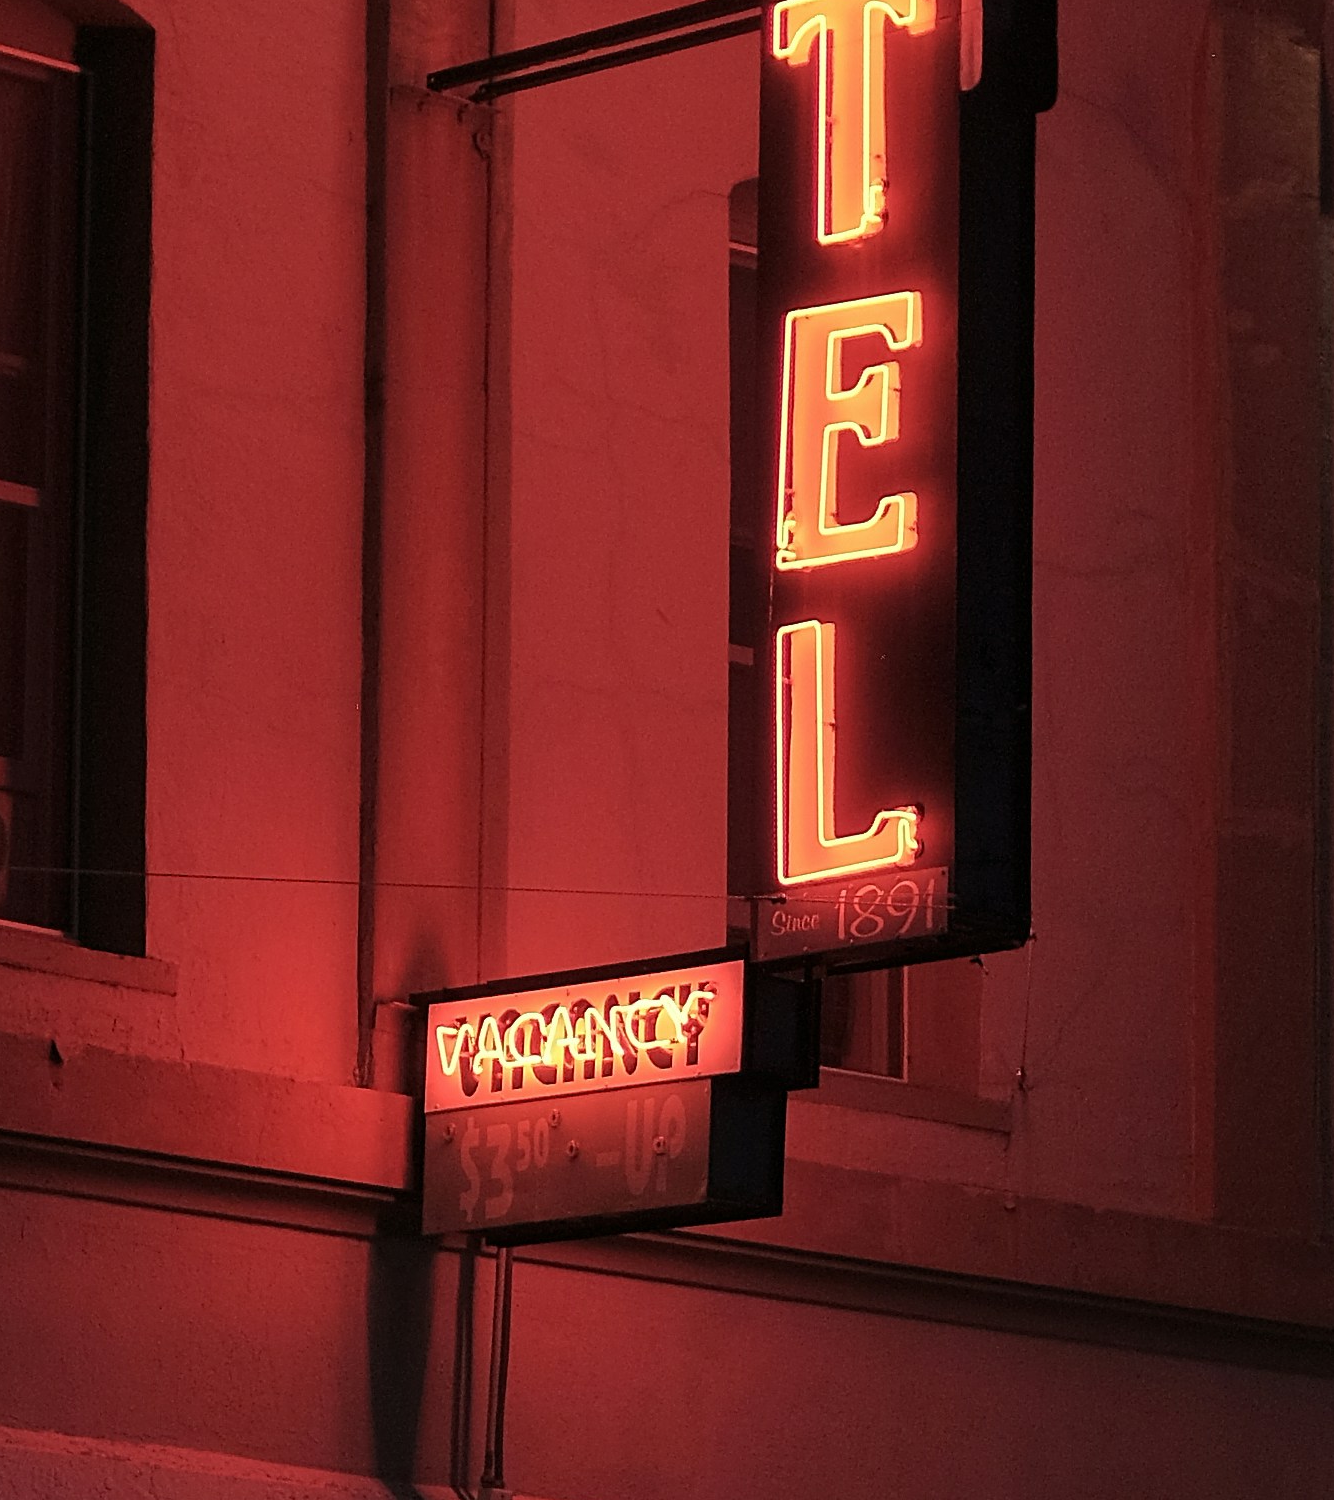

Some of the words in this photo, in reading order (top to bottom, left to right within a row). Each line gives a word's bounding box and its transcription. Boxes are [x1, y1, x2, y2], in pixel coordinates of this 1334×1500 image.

[770, 910, 820, 937] Since
[834, 877, 936, 941] 1891
[434, 980, 717, 1098] VACANCY
